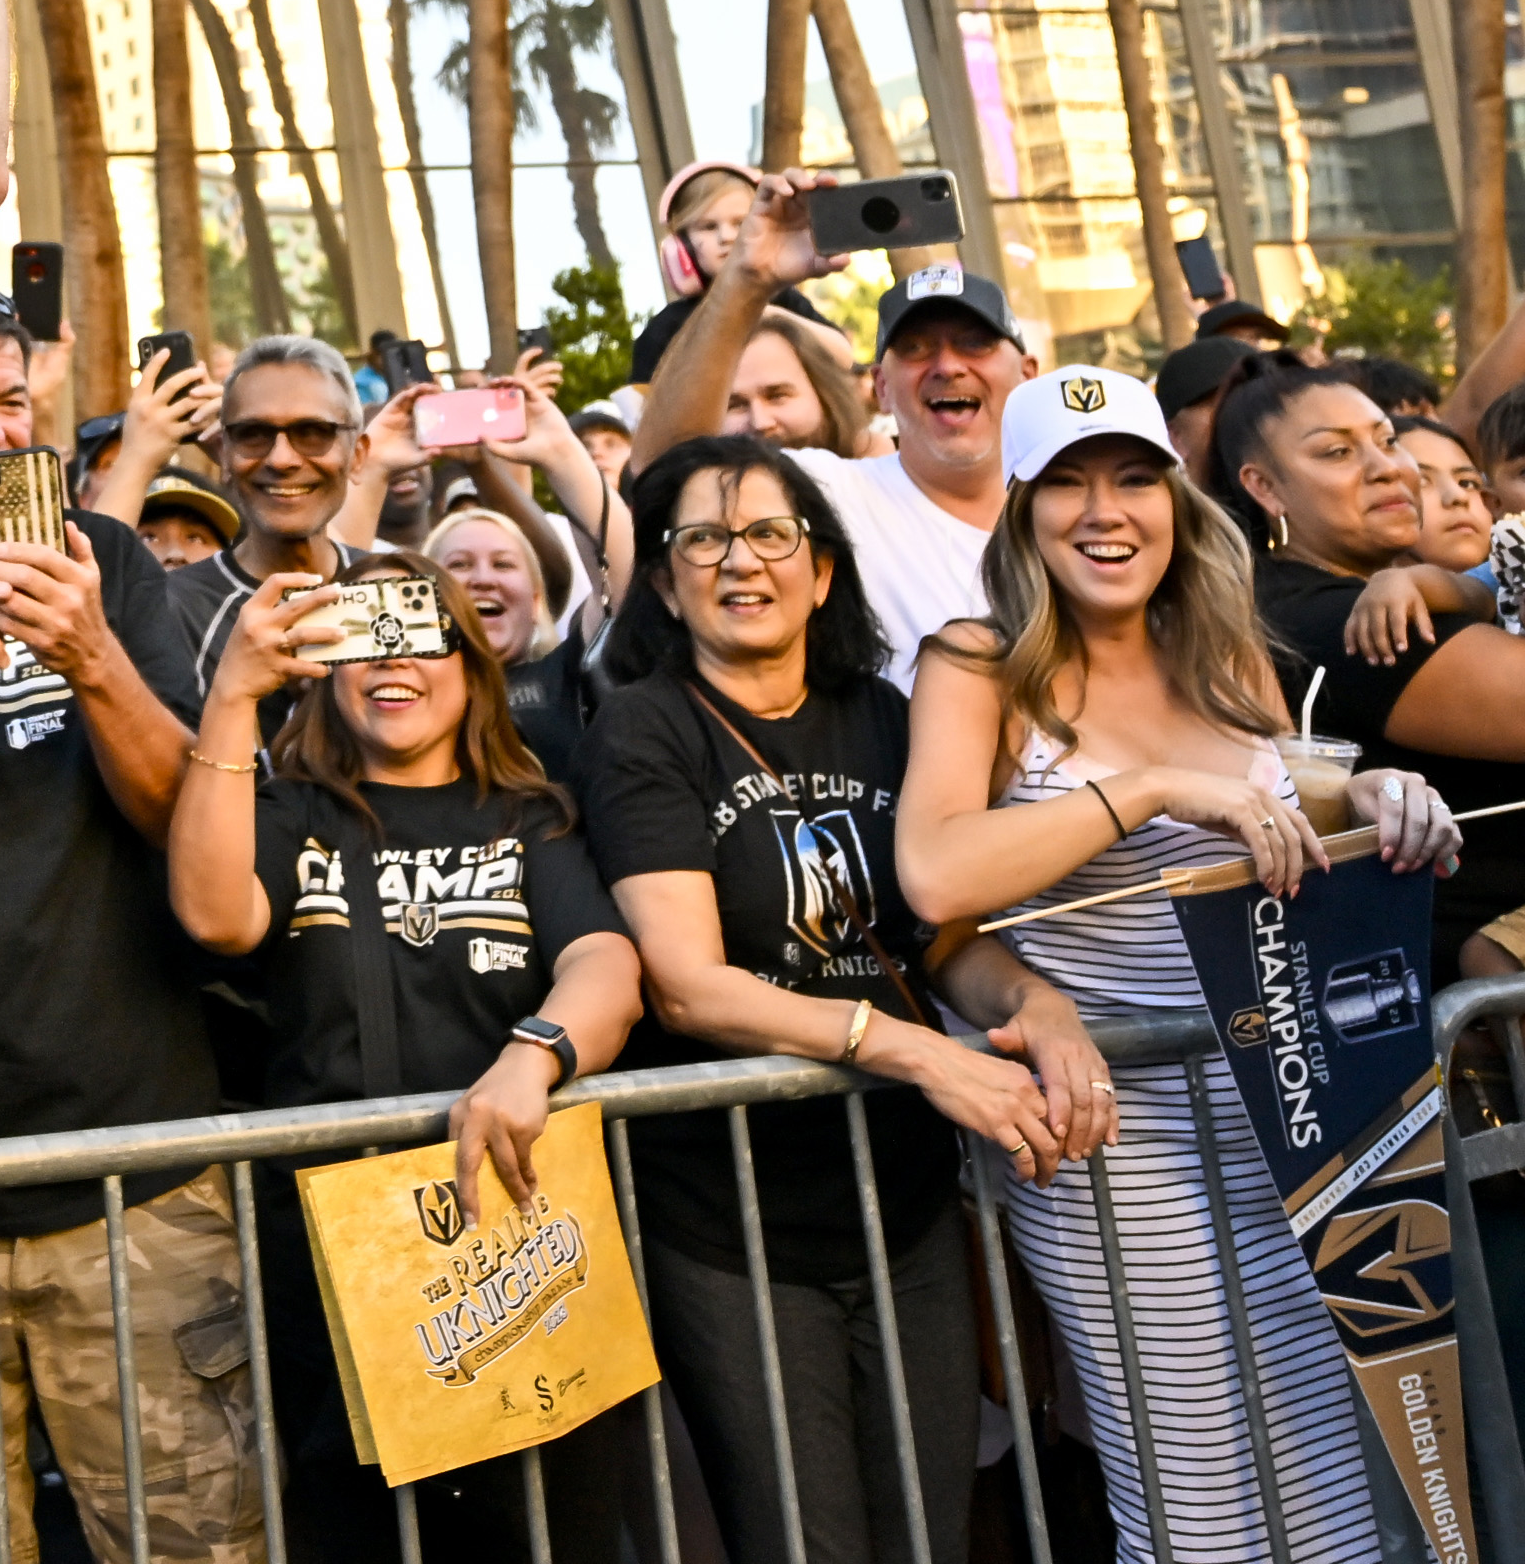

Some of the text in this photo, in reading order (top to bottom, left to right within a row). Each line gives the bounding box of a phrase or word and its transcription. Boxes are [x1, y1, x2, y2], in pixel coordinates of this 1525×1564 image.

[29, 717, 65, 734] FINAL
[811, 772, 866, 802] CUP
[494, 949, 527, 965] FINAL
[1253, 896, 1323, 1149] CHAMPIONS
[1290, 940, 1331, 1086] STANLEY CUP
[1373, 1123, 1411, 1163] STANLEY
[415, 1219, 577, 1366] UKNIGHTED
[422, 1275, 452, 1303] THE
[447, 1206, 544, 1298] REALM
[1398, 1372, 1469, 1564] GOLDEN KNIGHTS
